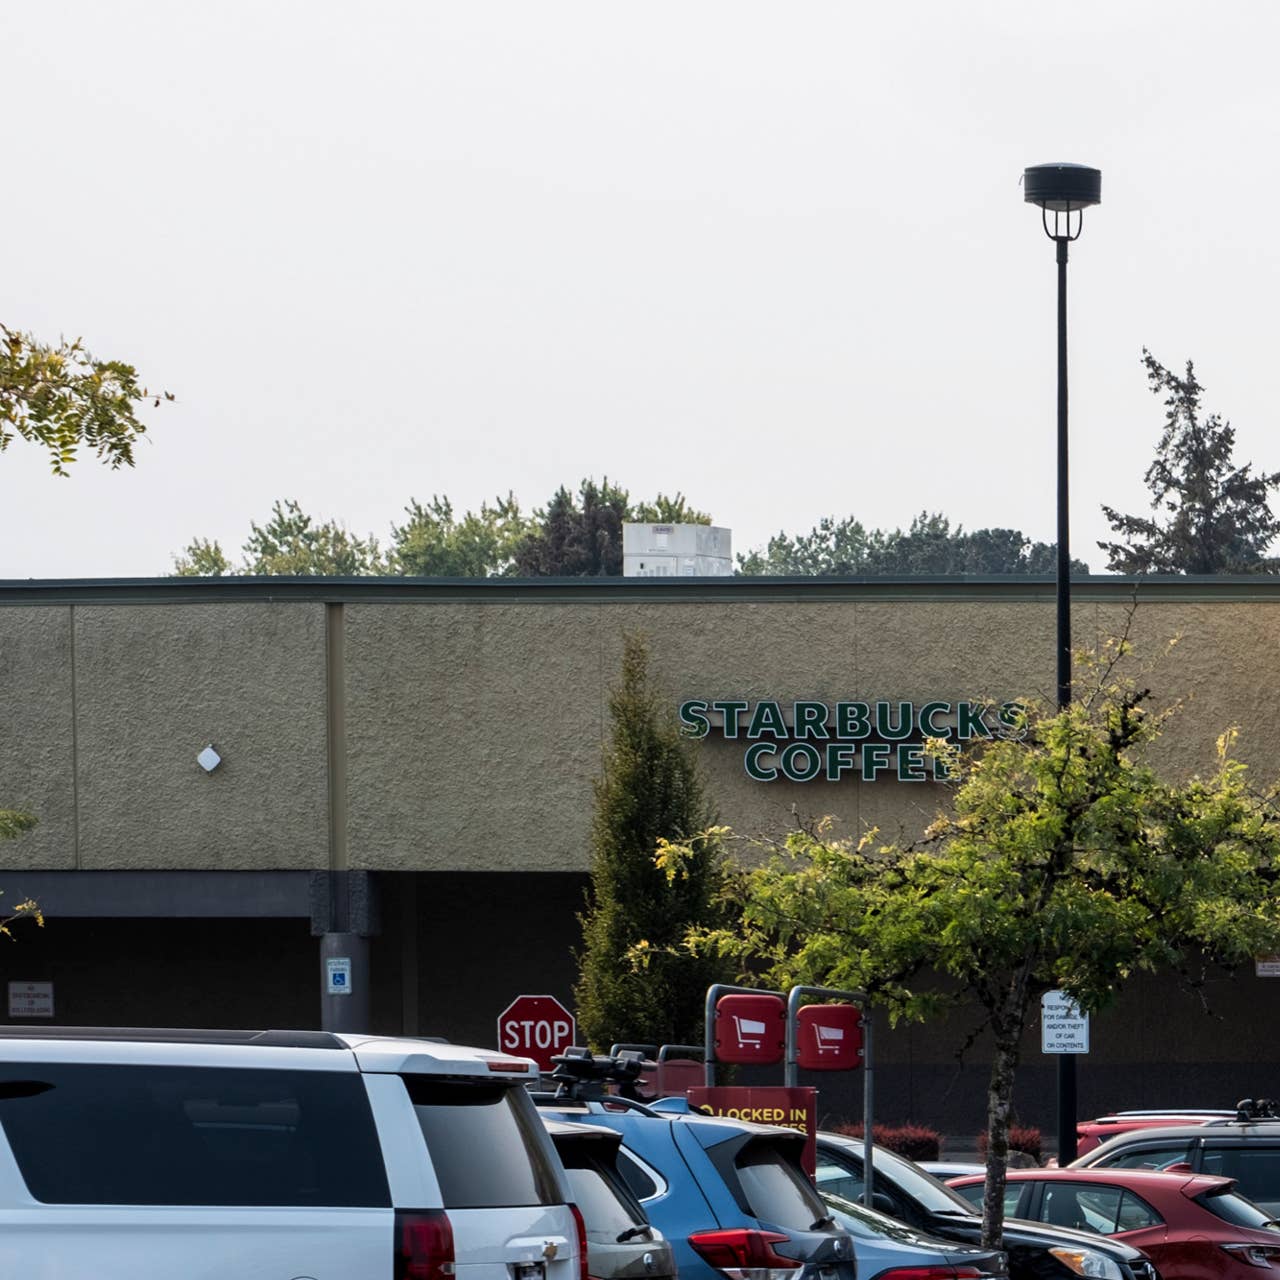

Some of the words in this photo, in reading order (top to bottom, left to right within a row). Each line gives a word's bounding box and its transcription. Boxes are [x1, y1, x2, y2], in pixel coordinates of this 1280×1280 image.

[679, 700, 1029, 740] STARBUCKS
[744, 742, 962, 781] COFFEE
[504, 1020, 570, 1049] STOP
[789, 1108, 807, 1120] IN
